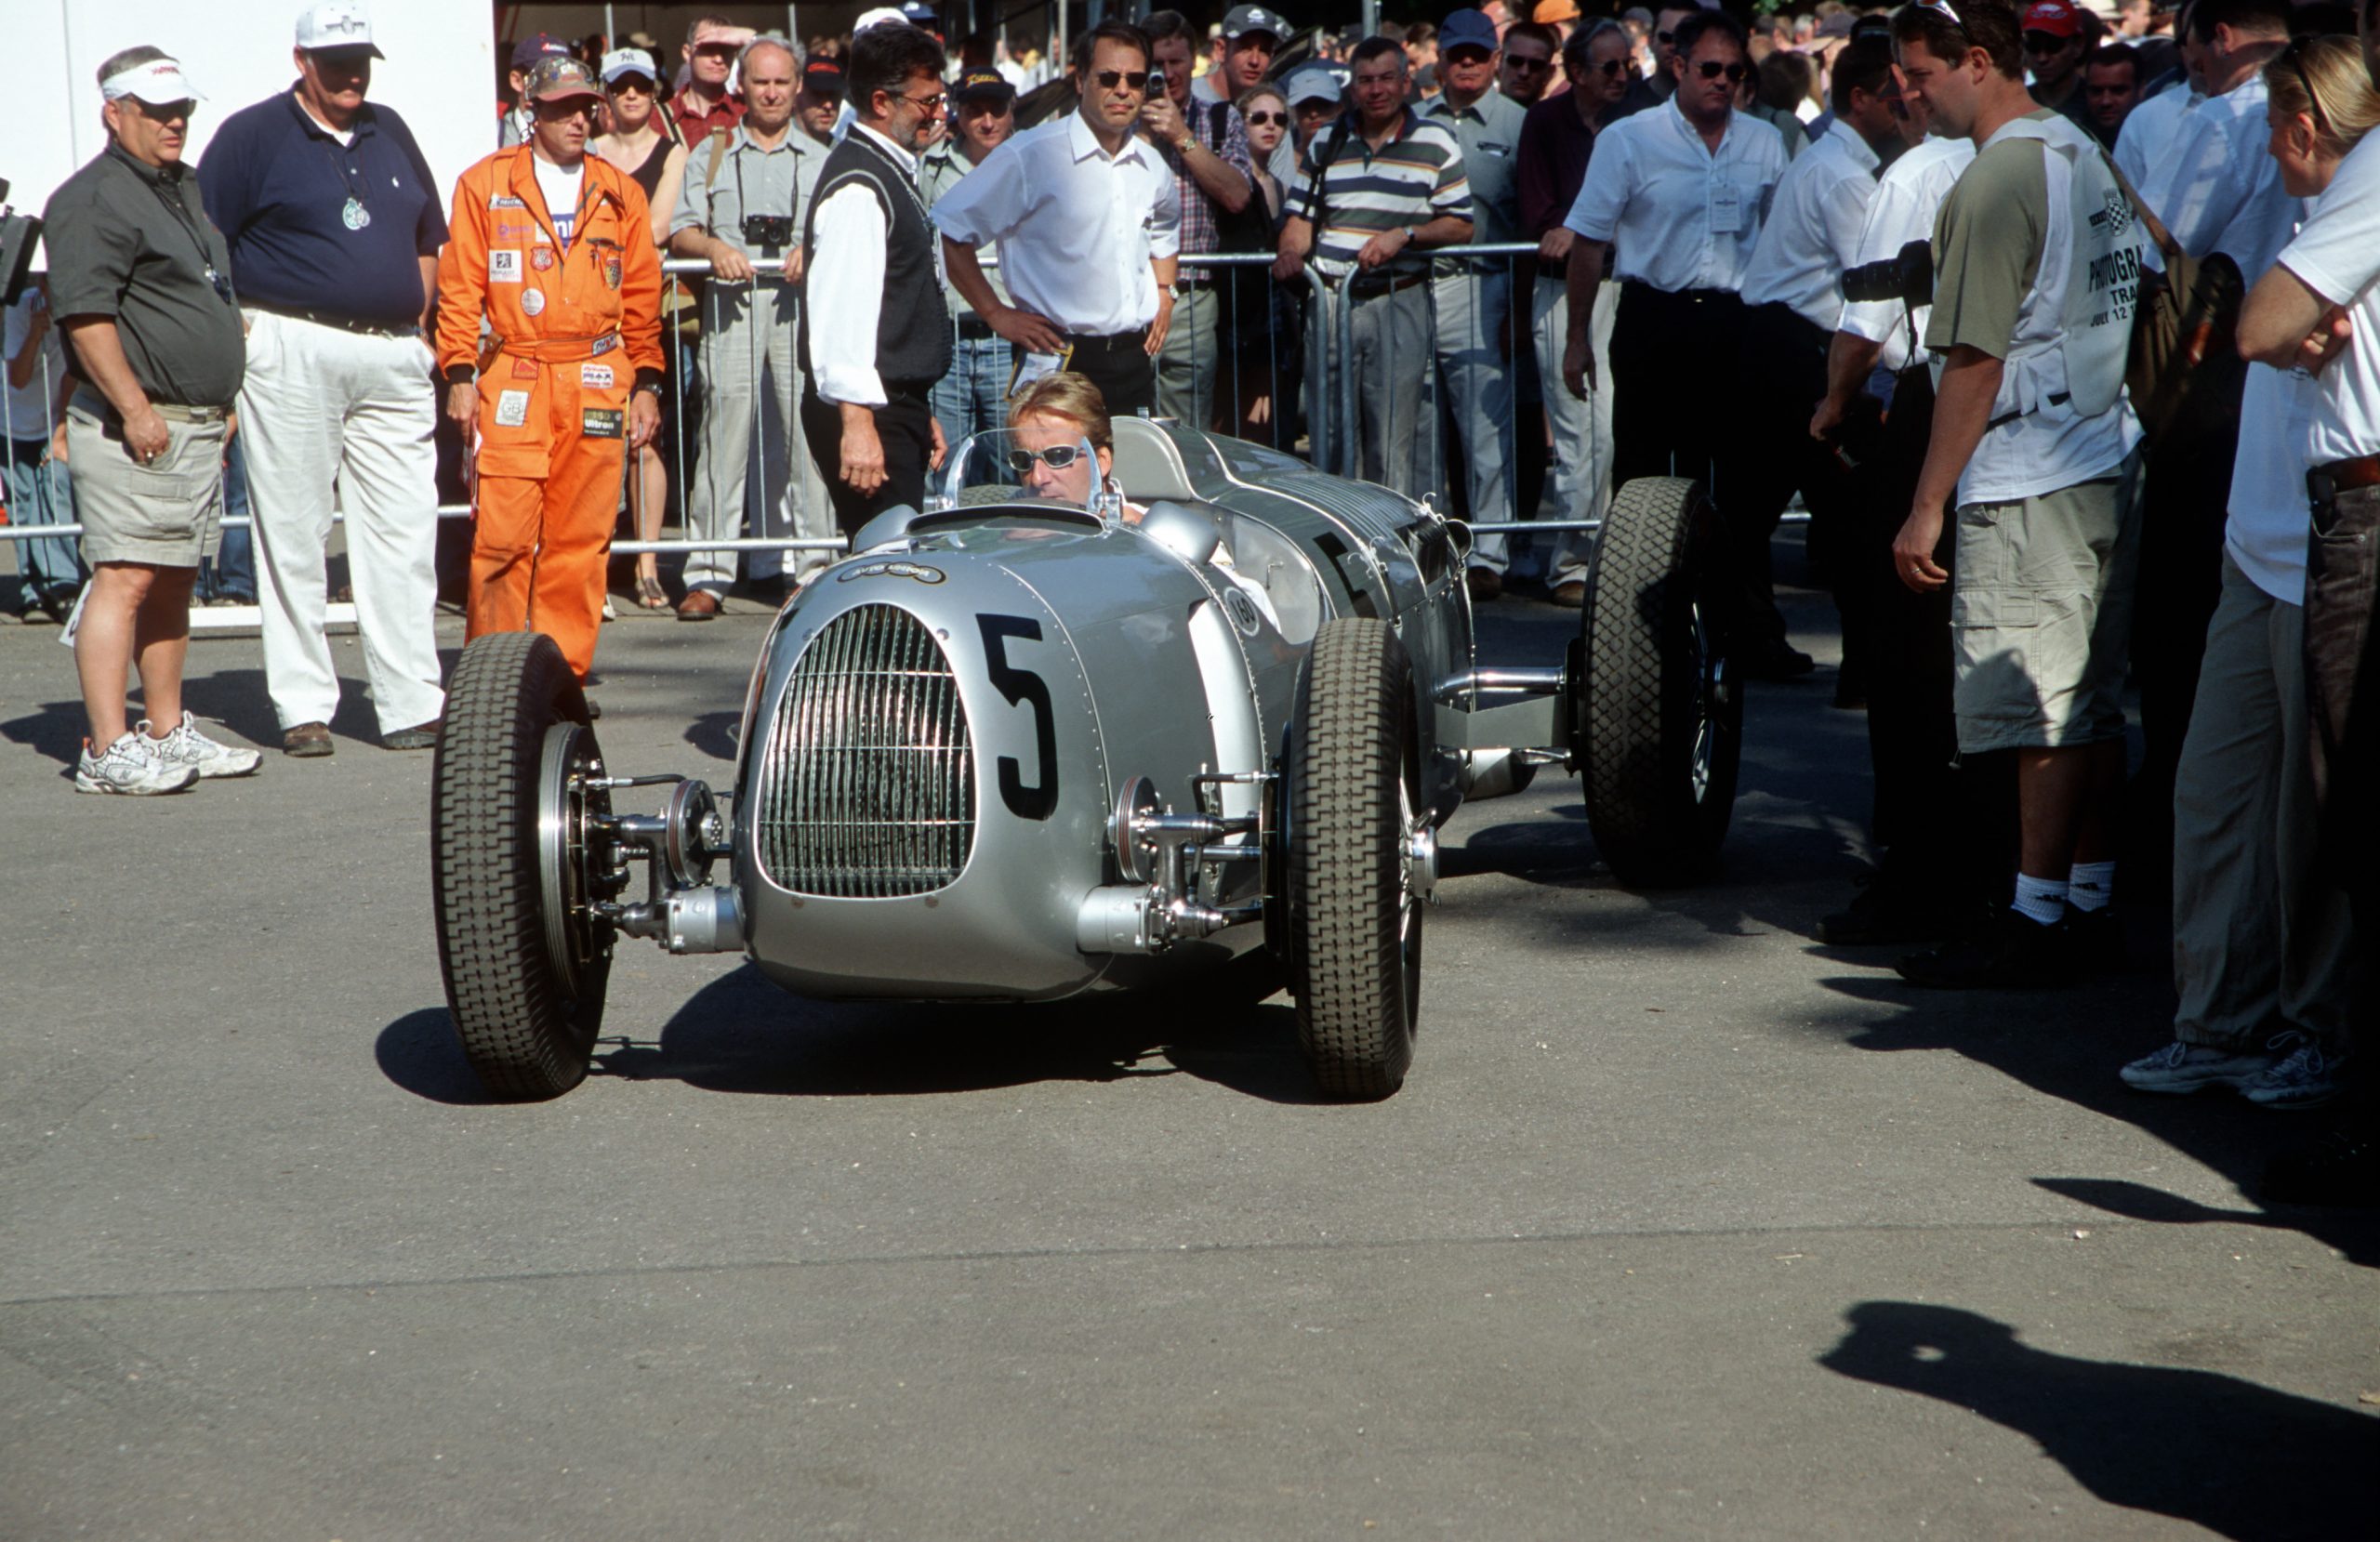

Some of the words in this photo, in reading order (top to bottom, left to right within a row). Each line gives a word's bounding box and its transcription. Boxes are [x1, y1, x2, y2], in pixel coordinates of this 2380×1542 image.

[2089, 244, 2144, 293] PHOTOGRA
[2110, 283, 2140, 305] TRA
[2090, 310, 2109, 327] JULY
[2112, 306, 2127, 321] 12
[1229, 597, 1256, 626] 160
[974, 613, 1059, 822] 5
